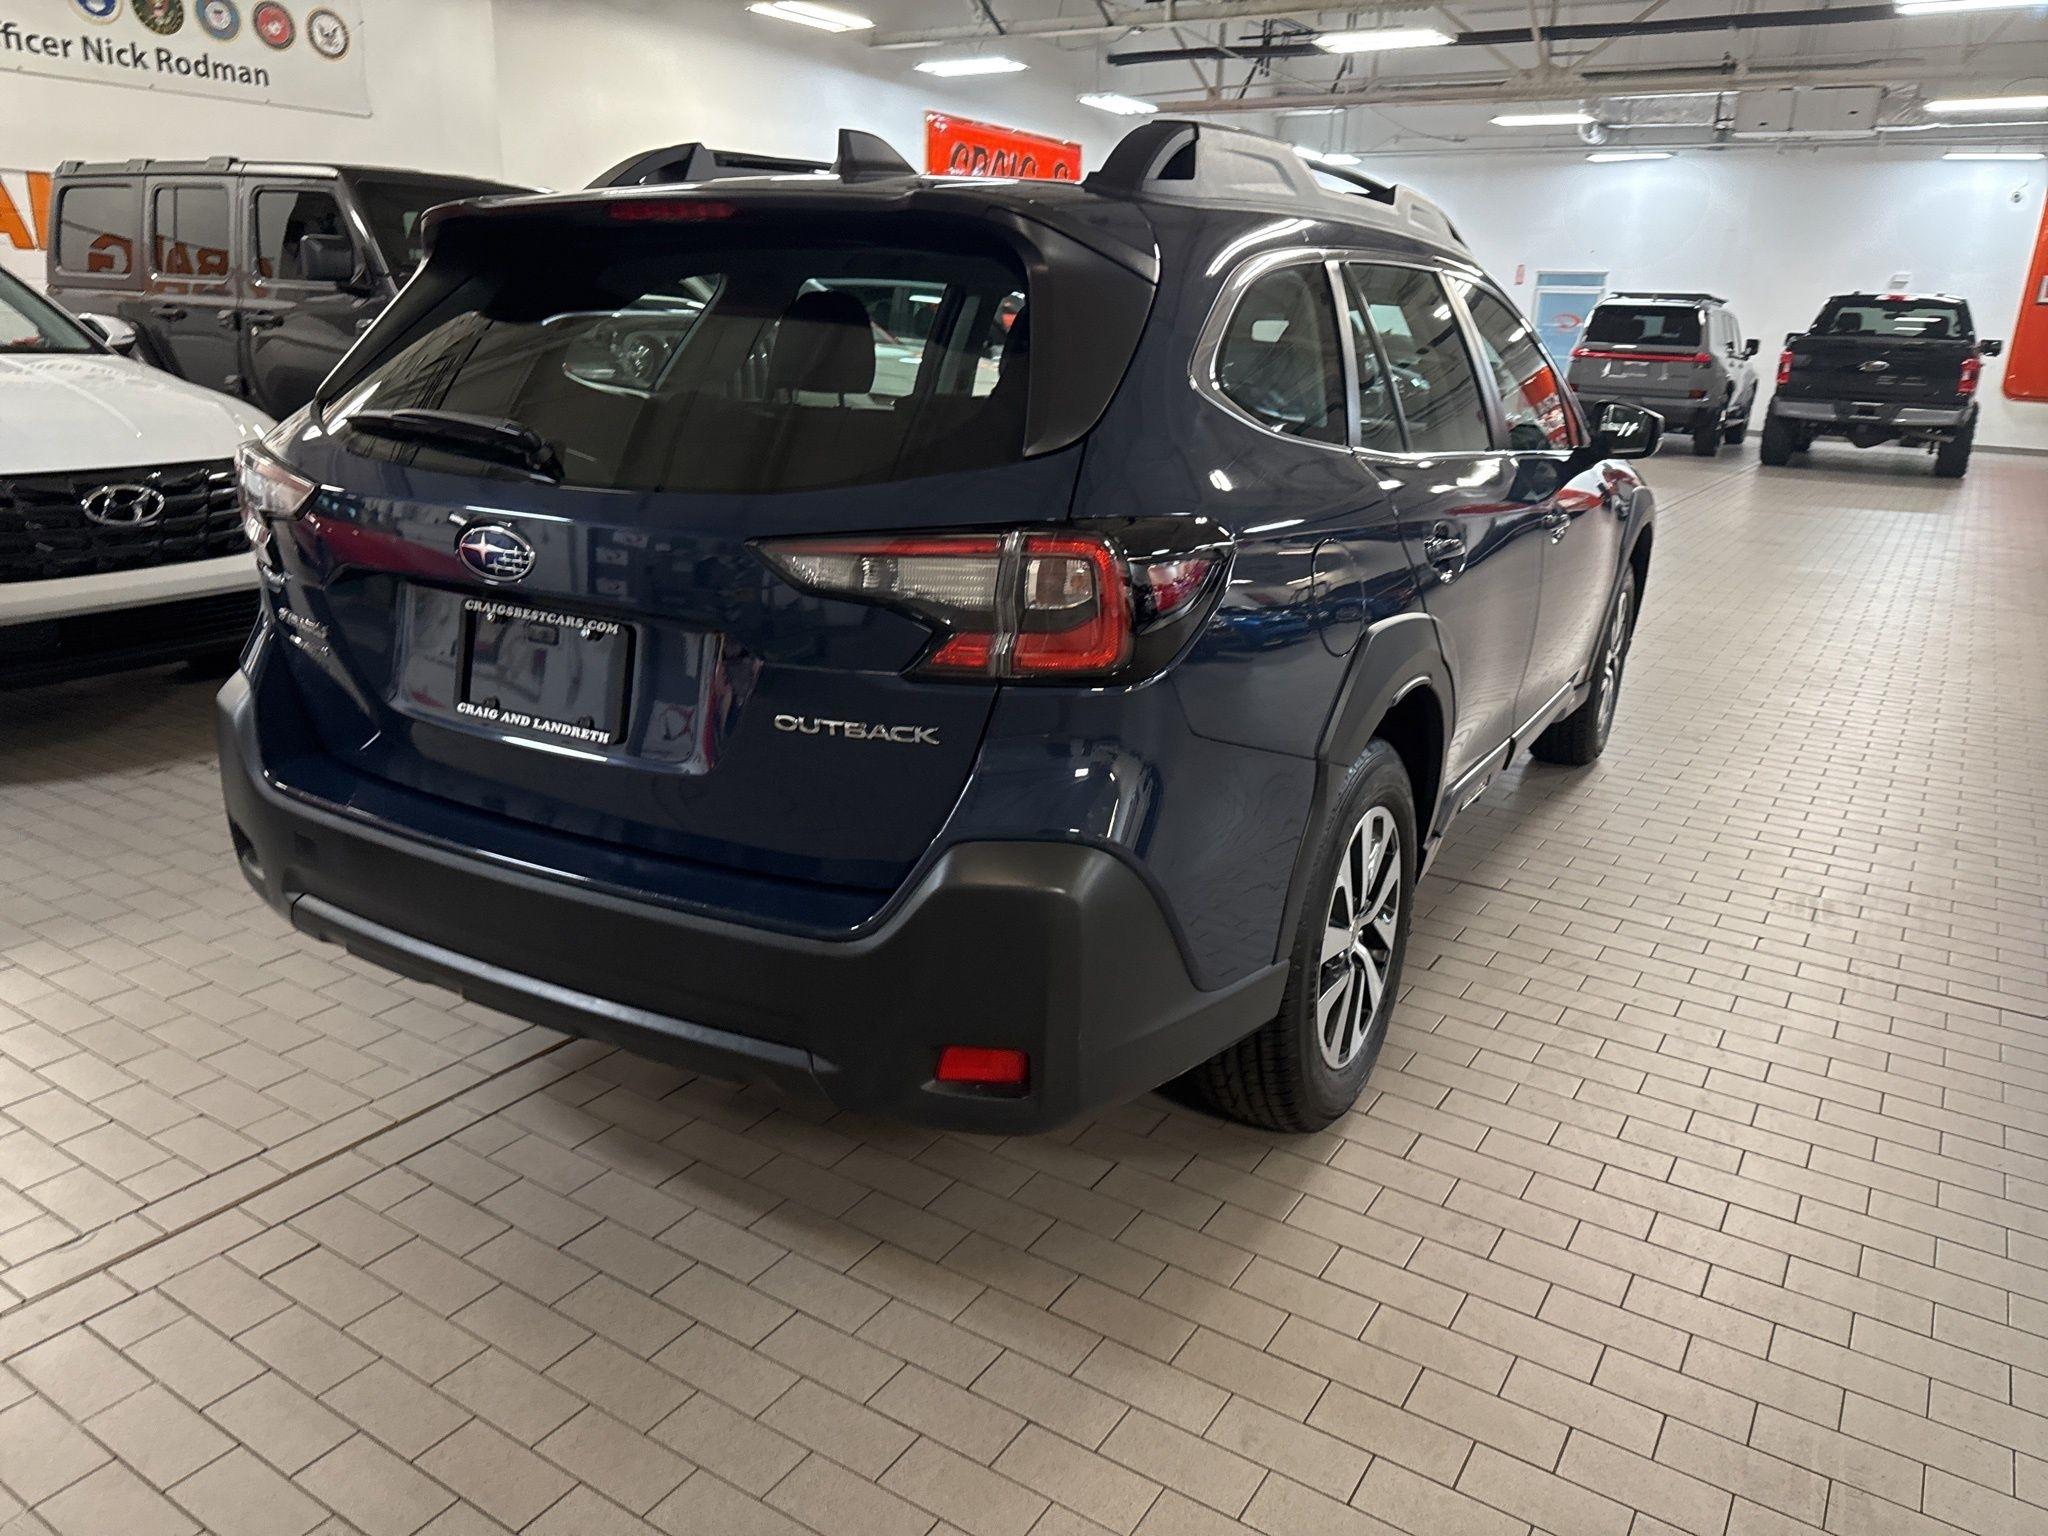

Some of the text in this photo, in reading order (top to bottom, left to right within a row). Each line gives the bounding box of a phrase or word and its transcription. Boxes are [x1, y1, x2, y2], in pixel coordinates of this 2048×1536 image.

[0, 21, 271, 87] ficer Nick Rodman
[464, 599, 620, 635] CRAIGSBESTCARS.COM
[456, 701, 611, 745] CRAIG AND LANDRETH
[773, 714, 941, 745] OUTBACK
